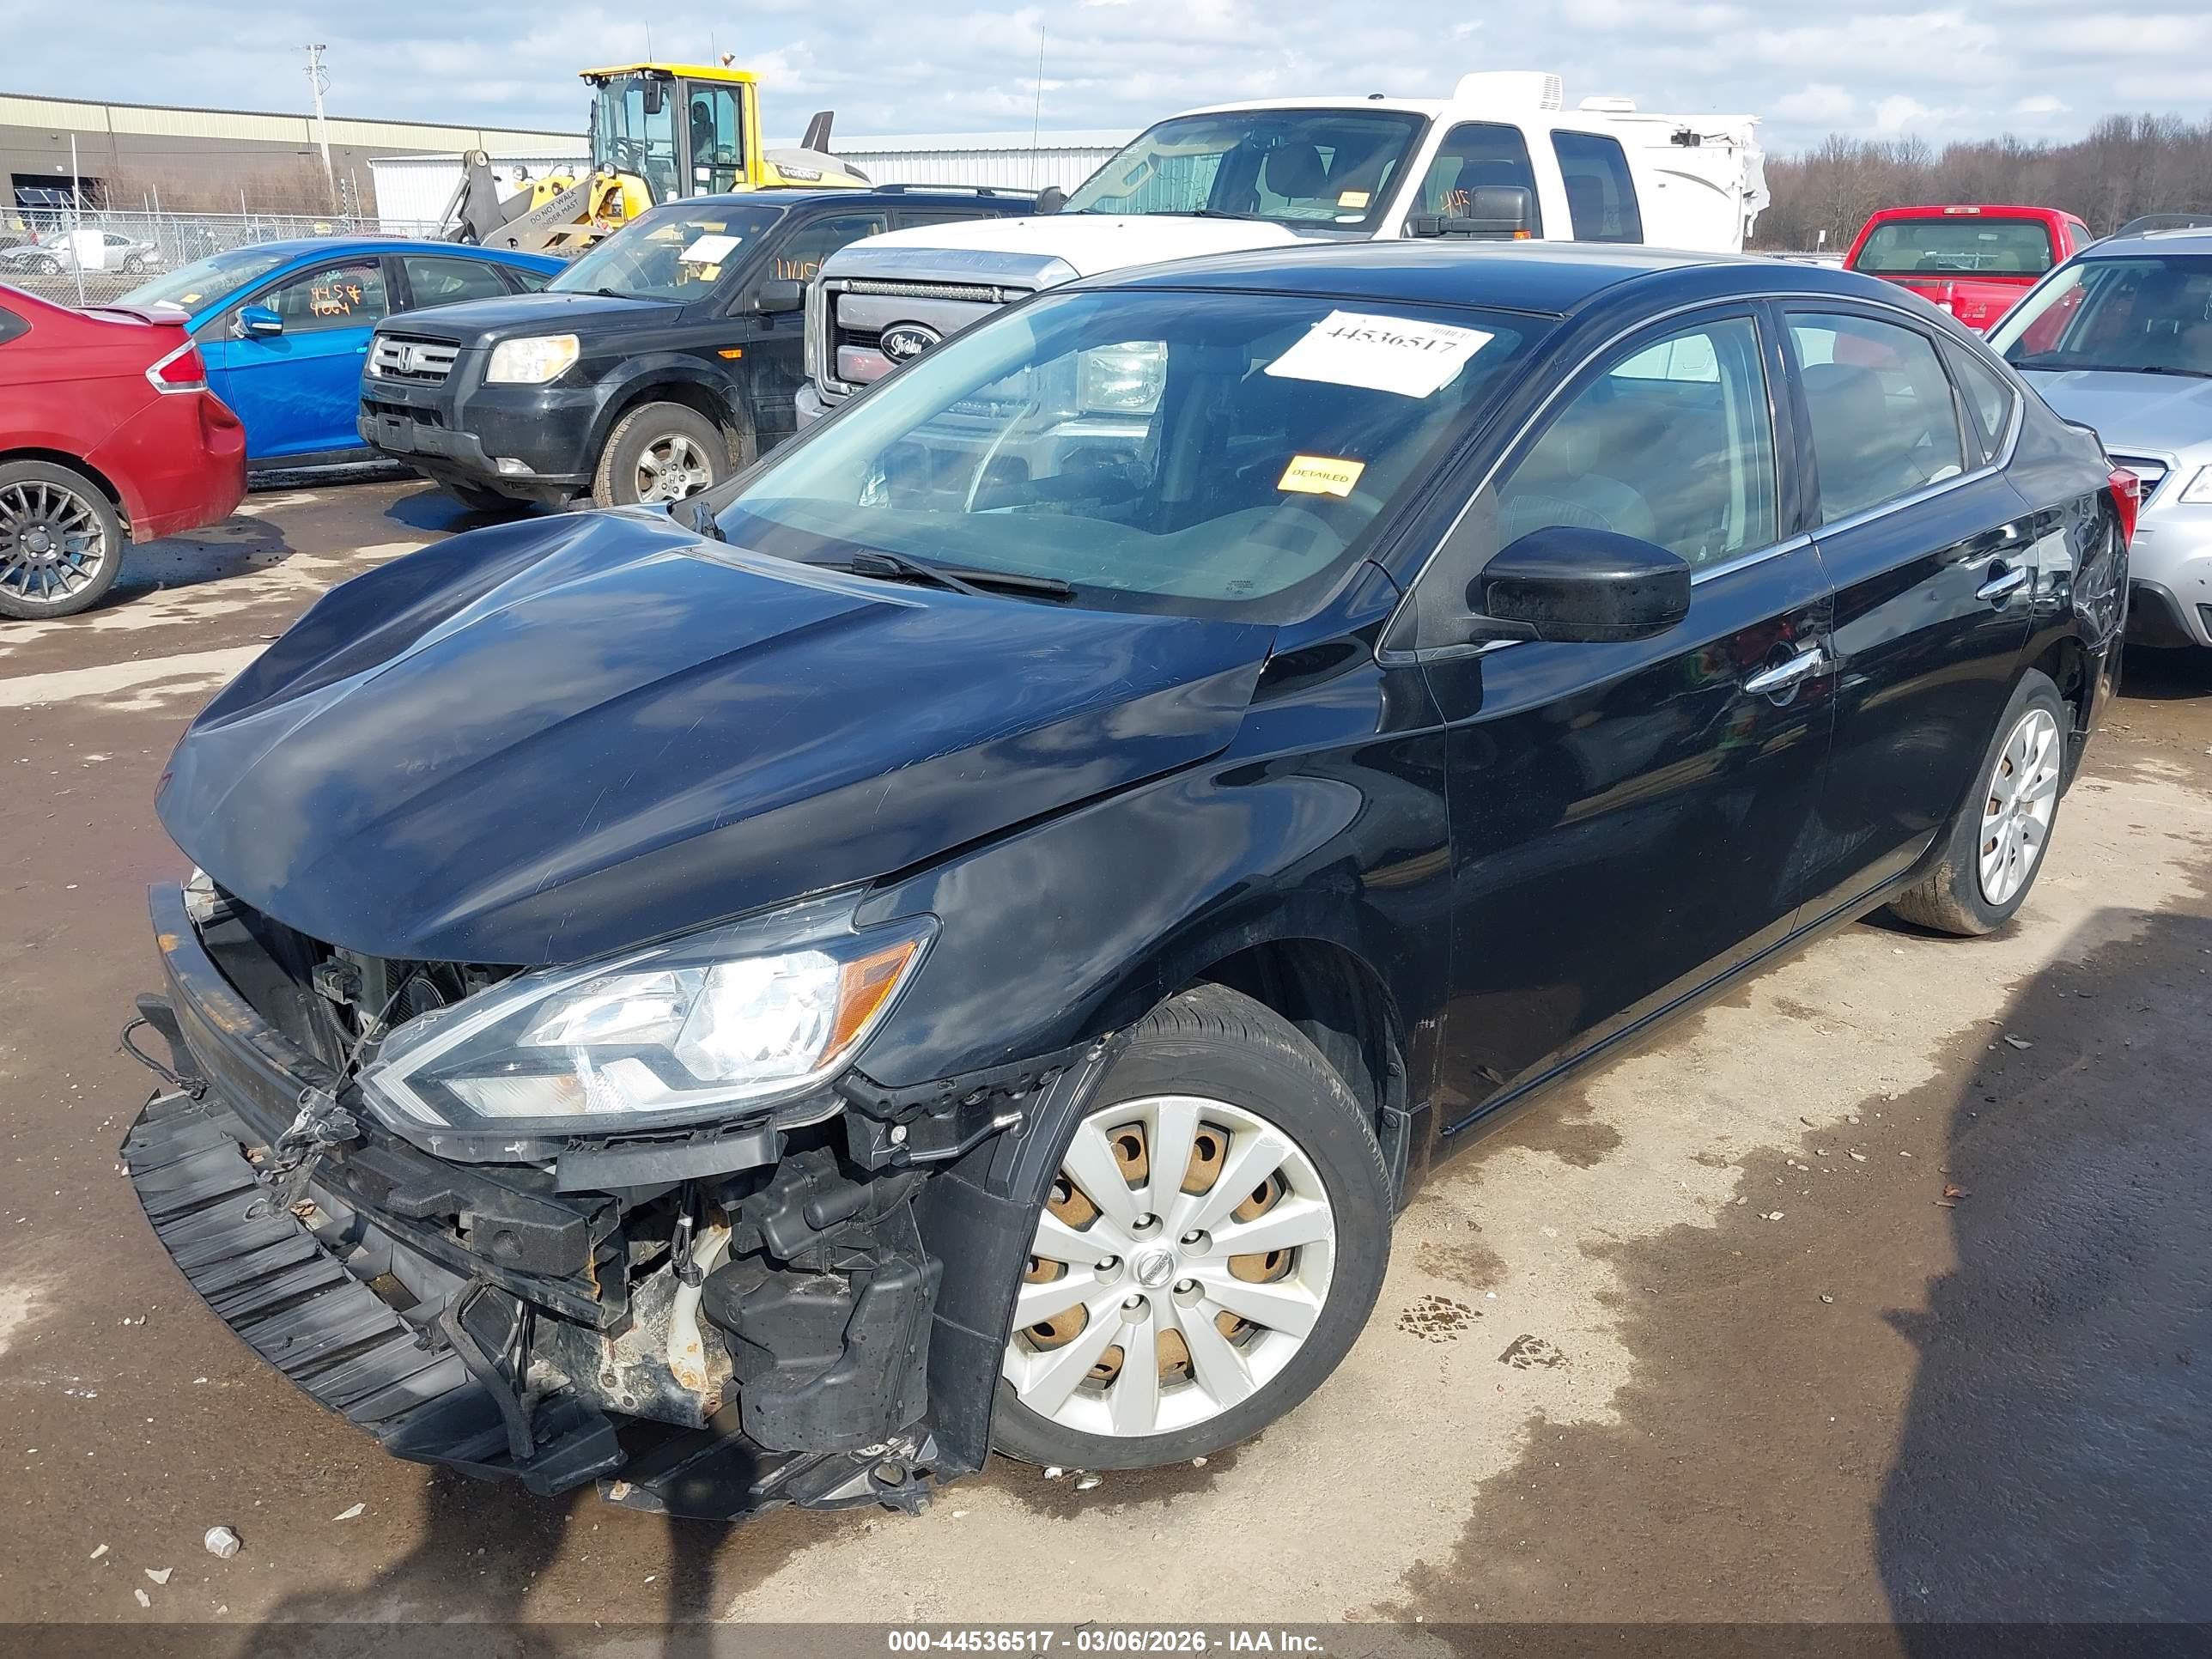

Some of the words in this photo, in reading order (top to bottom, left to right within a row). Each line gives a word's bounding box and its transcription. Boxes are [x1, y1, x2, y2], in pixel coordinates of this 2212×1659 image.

[780, 167, 821, 179] VOLVO
[530, 214, 542, 225] DO
[541, 203, 556, 217] NOT
[556, 190, 577, 205] WALK
[561, 198, 580, 215] MAST
[1327, 326, 1458, 354] 44536517
[1292, 469, 1349, 483] DETAILED
